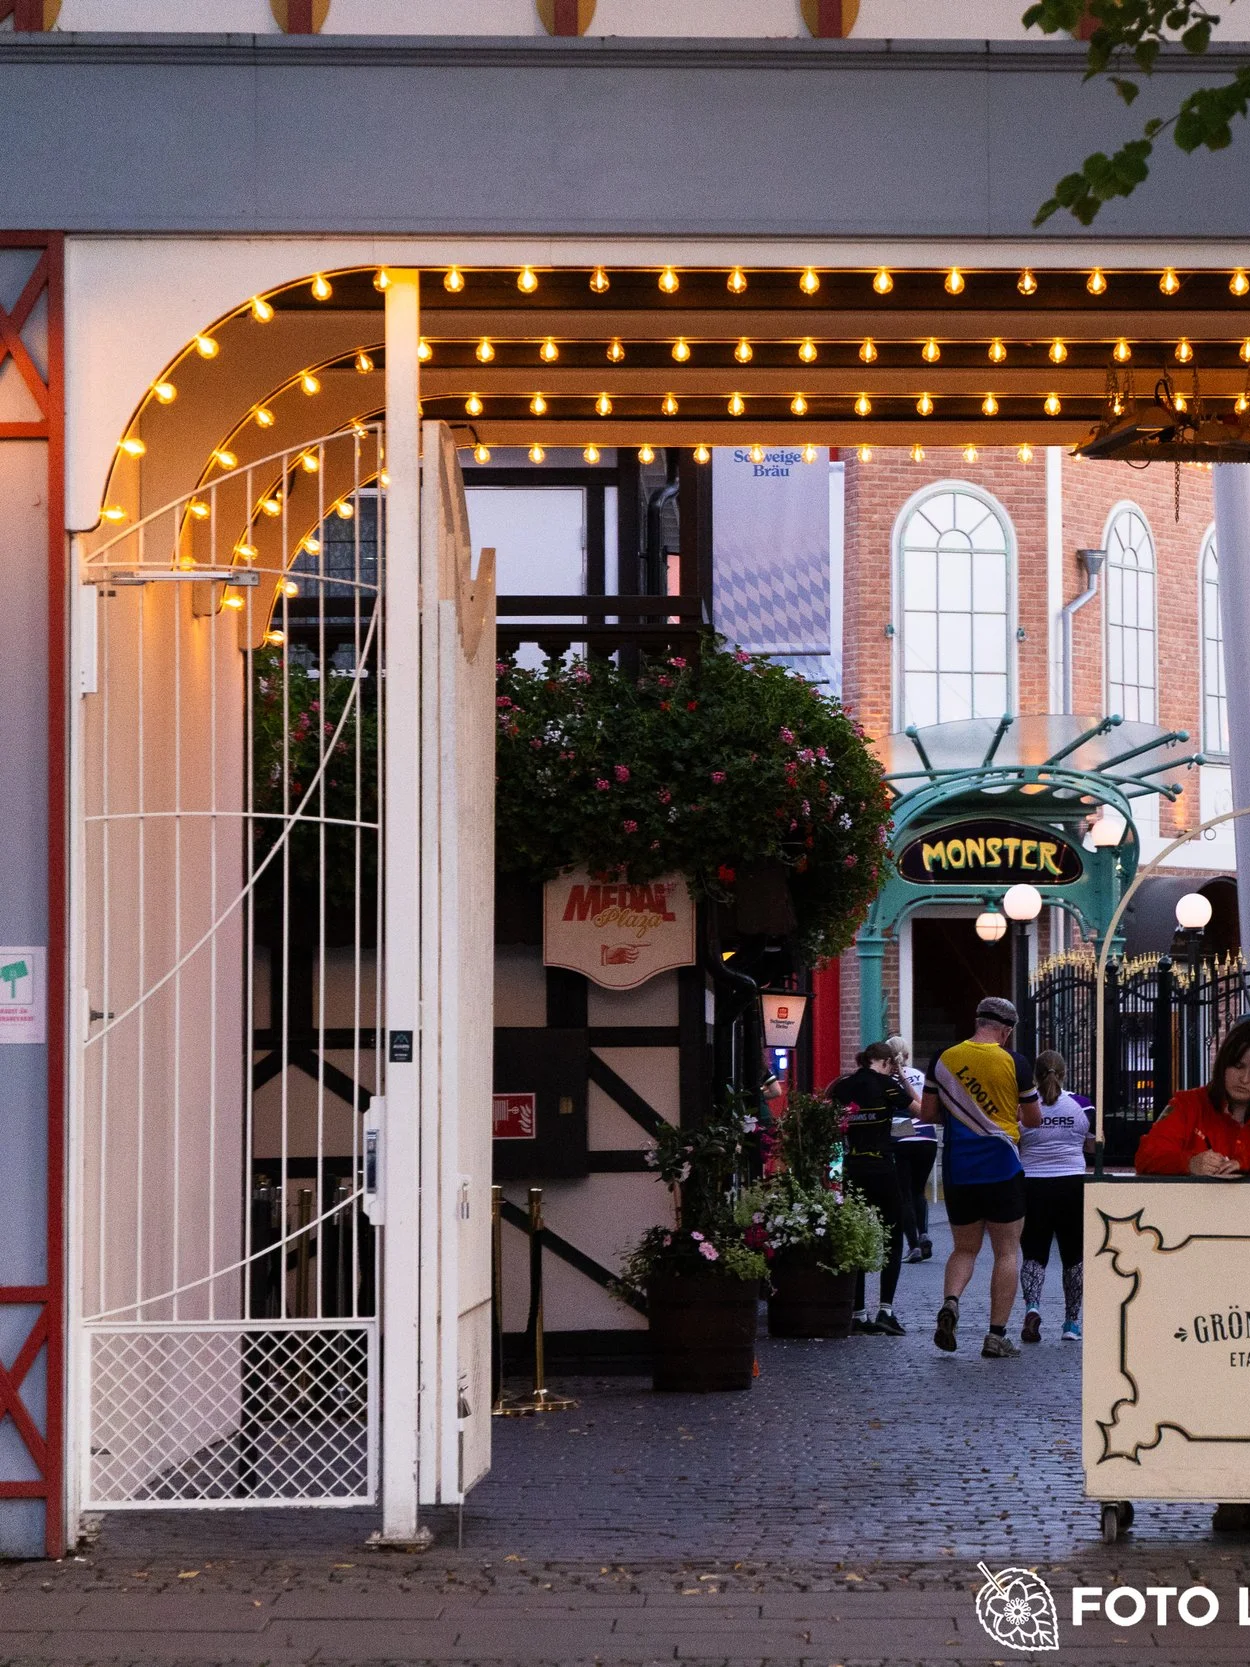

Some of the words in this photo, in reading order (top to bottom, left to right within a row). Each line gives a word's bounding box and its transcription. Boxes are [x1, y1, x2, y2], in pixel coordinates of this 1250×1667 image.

[734, 450, 803, 465] Scweige
[753, 465, 790, 477] Bräu
[922, 837, 1063, 875] MONSTER
[562, 884, 676, 921] MEDAL
[594, 905, 663, 938] Plaza
